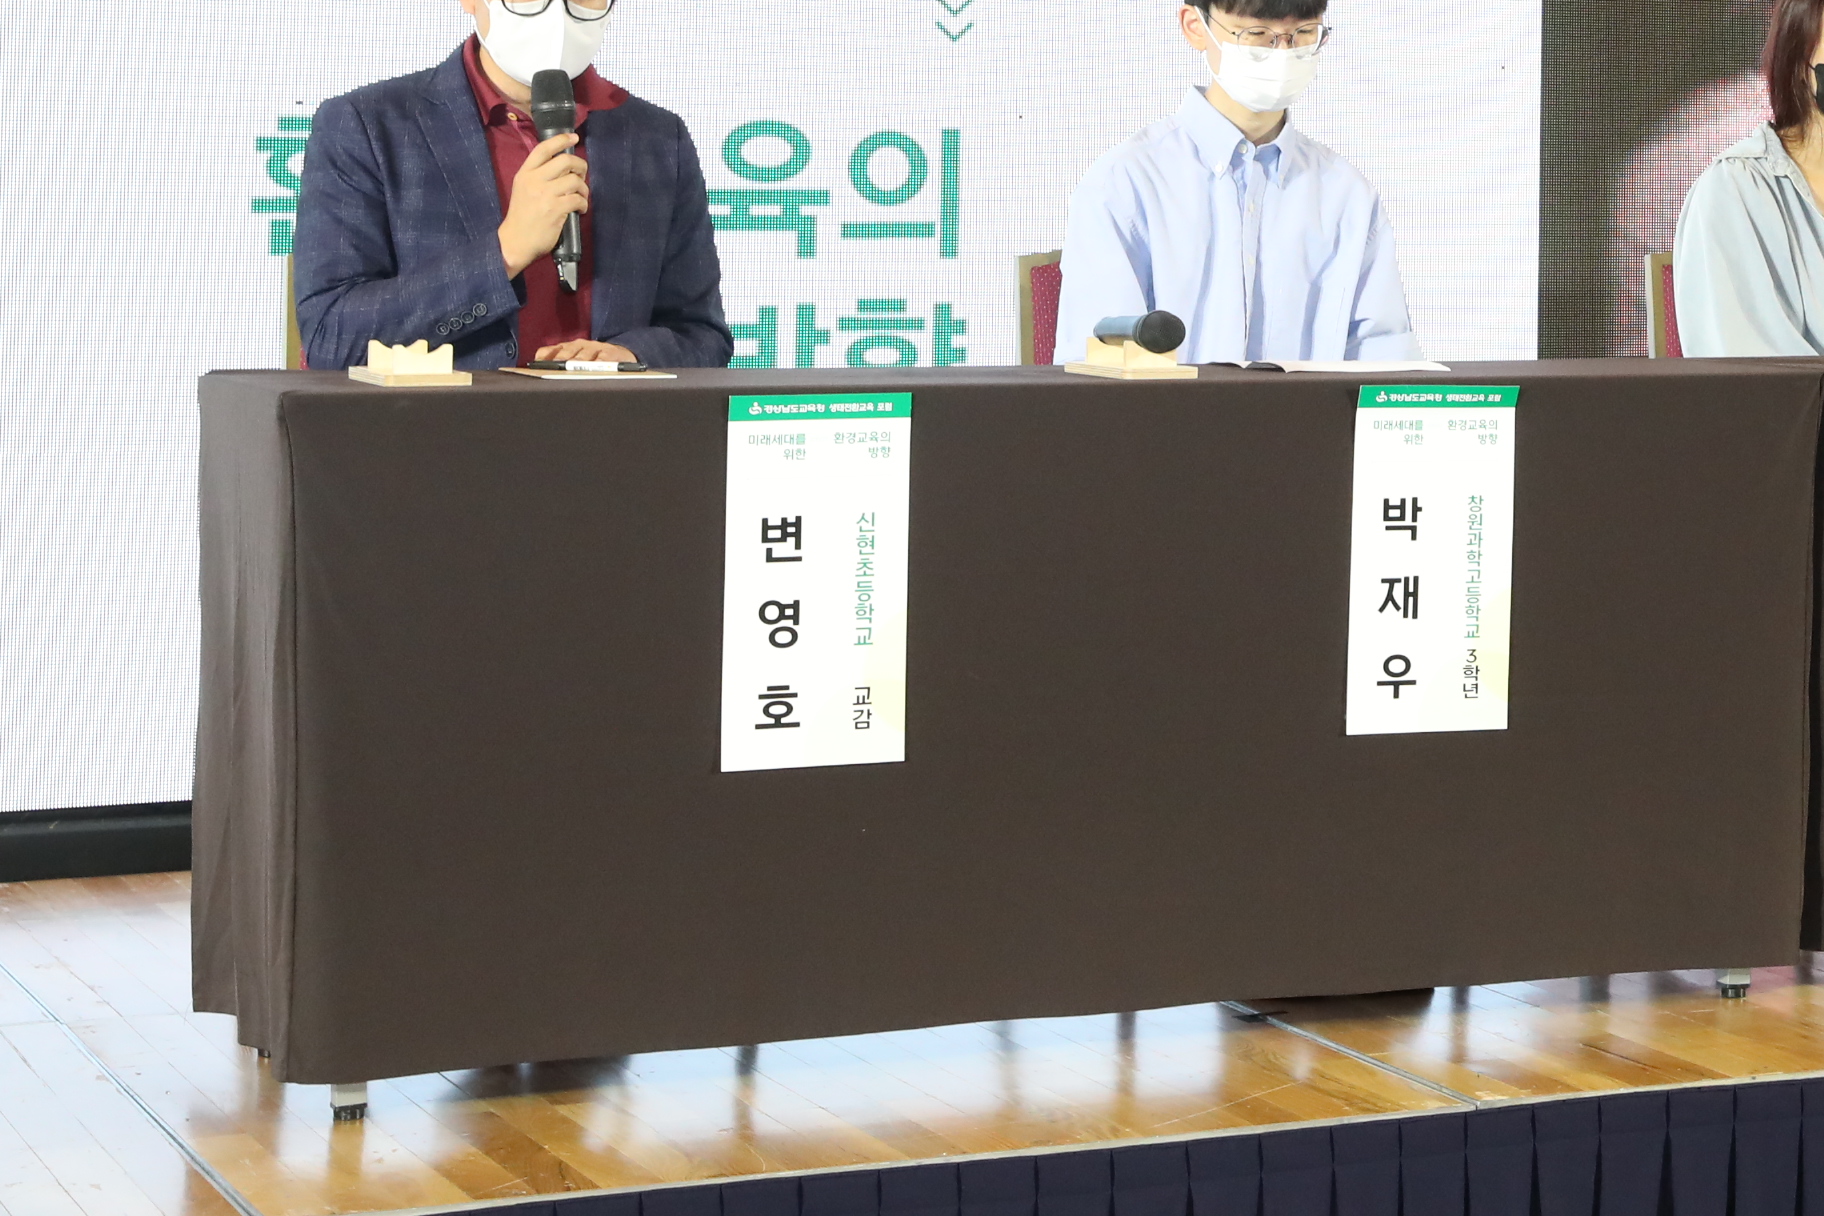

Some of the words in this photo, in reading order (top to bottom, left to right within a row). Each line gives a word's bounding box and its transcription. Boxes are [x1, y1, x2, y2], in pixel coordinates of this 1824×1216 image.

[764, 404, 825, 413] 경상남도교육청
[829, 403, 874, 412] 생태전환교육
[877, 402, 892, 411] 포럼
[1373, 420, 1423, 431] 미래세대를
[1447, 420, 1498, 430] 환경교육의
[748, 433, 806, 446] 미래세대를
[834, 431, 891, 444] 환경교육의
[1403, 434, 1423, 445] 위한
[1478, 434, 1498, 445] 방향
[783, 448, 806, 460] 위한
[868, 446, 891, 459] 방향
[1465, 495, 1484, 638] 창원과학고등학교
[854, 512, 874, 645] 신현초등학교
[1463, 649, 1480, 698] 3학년
[853, 687, 872, 729] 교감
